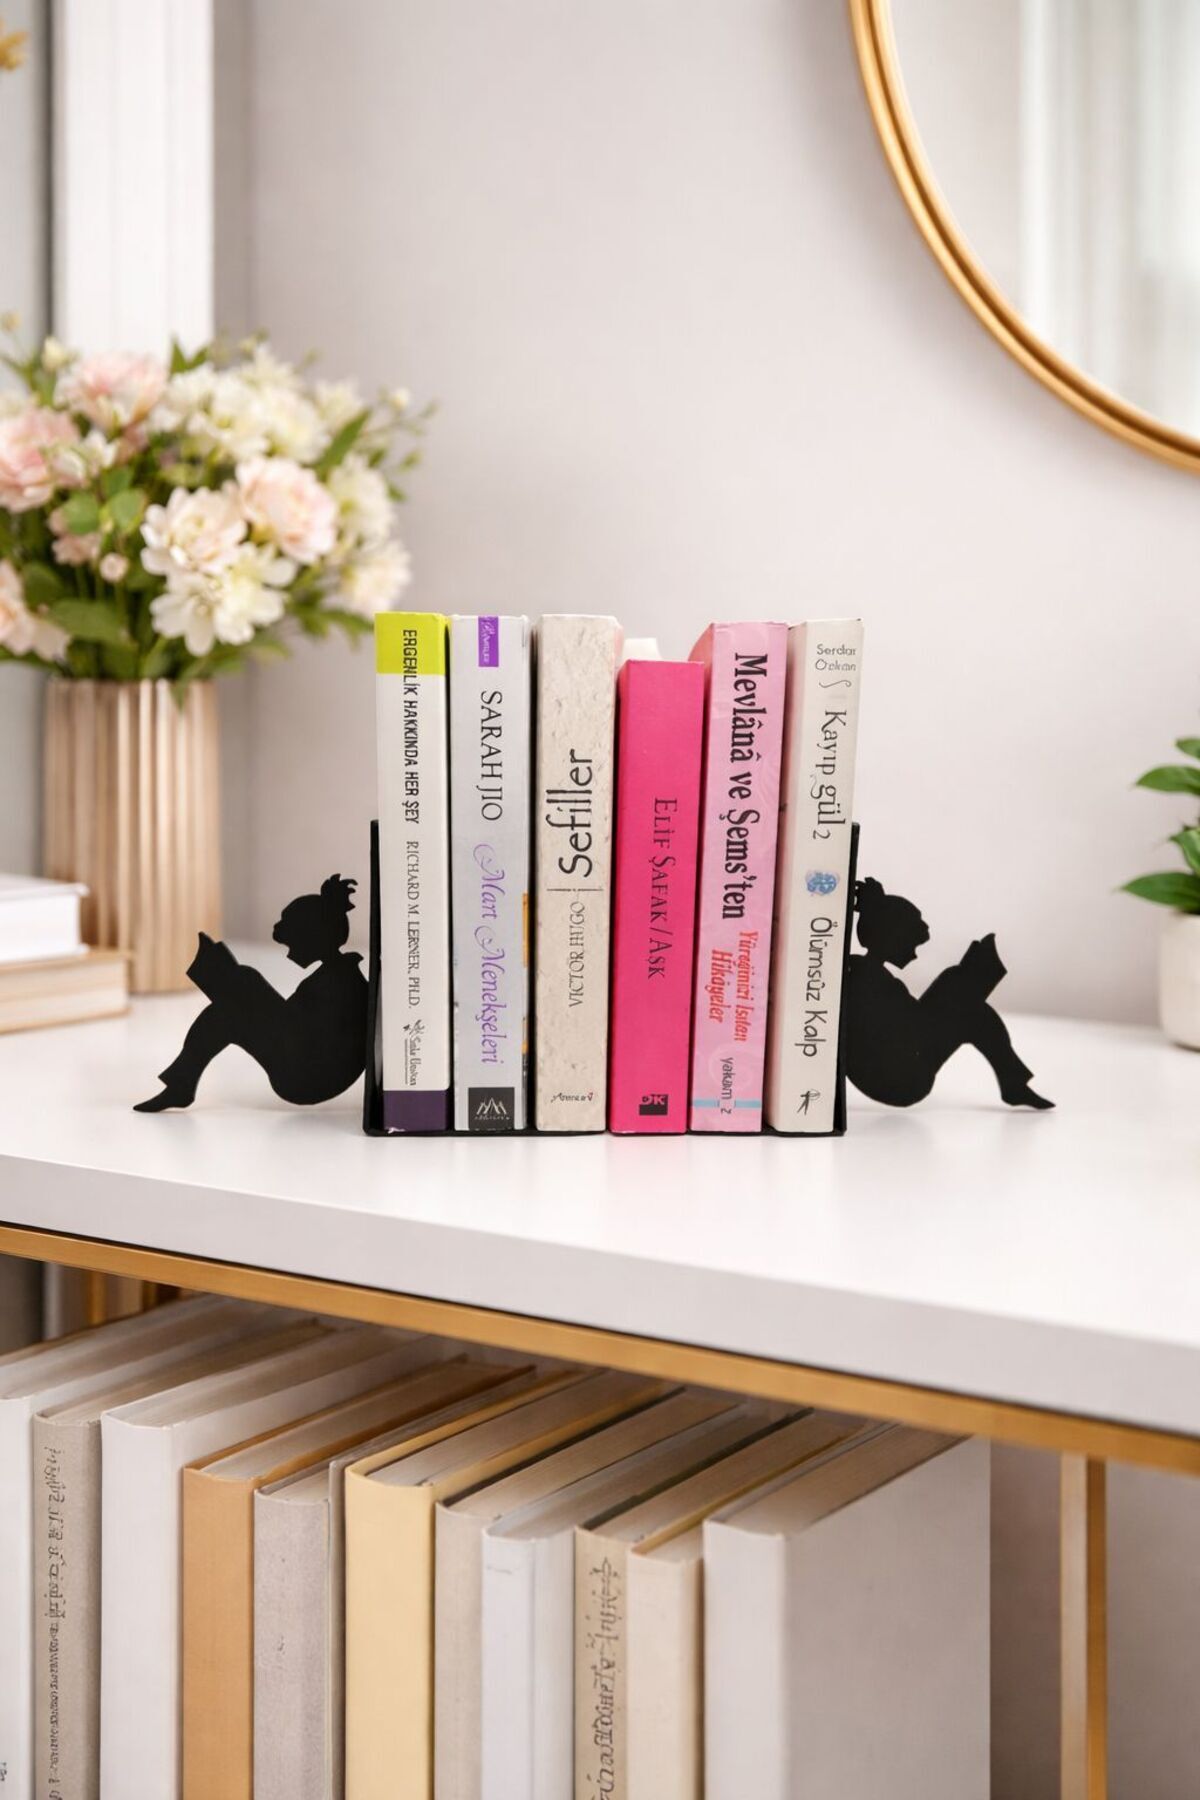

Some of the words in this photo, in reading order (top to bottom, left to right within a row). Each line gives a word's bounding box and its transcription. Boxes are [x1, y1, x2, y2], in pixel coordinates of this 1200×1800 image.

[403, 629, 420, 695] ERGENLİK
[404, 700, 419, 767] HAKKINDA
[480, 690, 502, 780] SARAH
[730, 652, 768, 763] Mevlânâ
[815, 710, 847, 775] Kayıp
[402, 801, 420, 824] ŞEY
[405, 771, 419, 796] HER
[476, 785, 503, 821] JIO
[728, 771, 752, 799] ve
[810, 784, 846, 825] gül
[545, 748, 593, 878] Sefiller
[813, 829, 831, 840] 2
[406, 841, 420, 900] RICHARD
[473, 844, 506, 919] Mart
[408, 904, 420, 917] M.
[569, 901, 585, 947] HUGO
[569, 950, 585, 1008] VICTOR
[806, 917, 838, 1002] Ölümsüz
[474, 925, 507, 1064] Menekşeleri
[795, 1011, 828, 1058] Kalp
